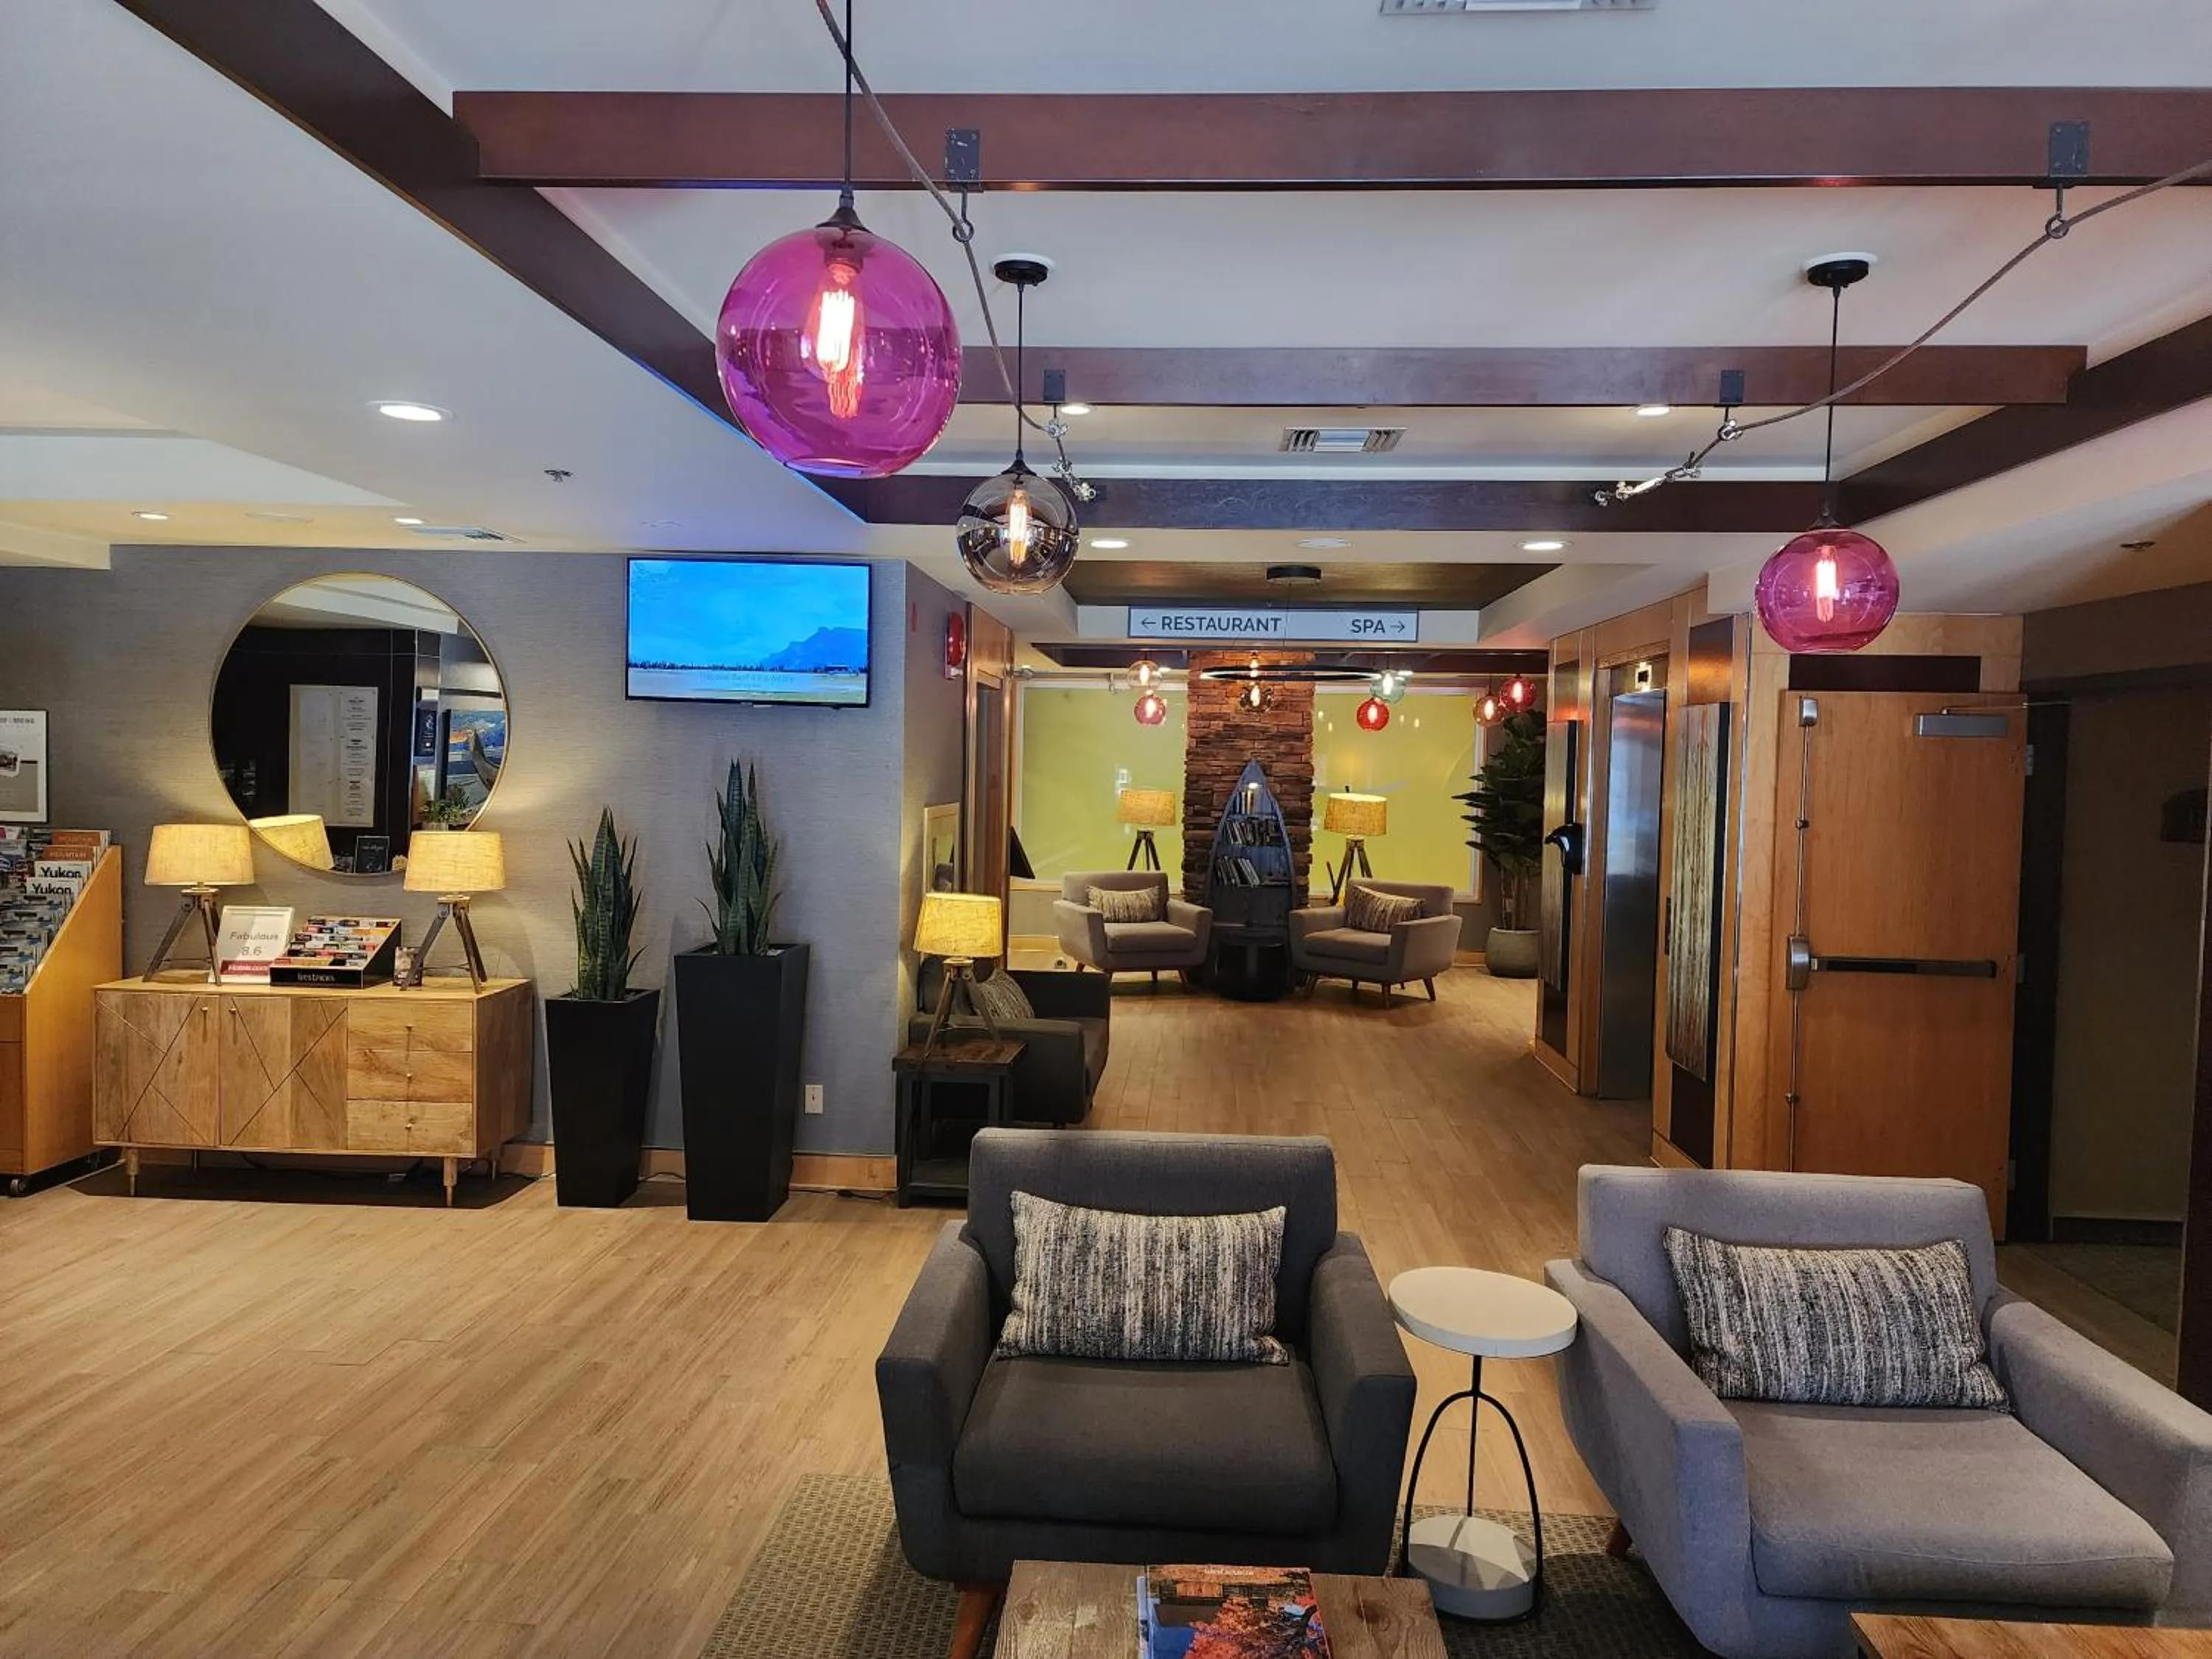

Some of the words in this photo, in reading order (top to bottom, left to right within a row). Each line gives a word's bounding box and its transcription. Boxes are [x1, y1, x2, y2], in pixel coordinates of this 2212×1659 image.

[1161, 616, 1282, 633] RESTAURANT
[1350, 619, 1386, 634] SPA
[41, 866, 83, 877] Yukon
[32, 883, 72, 894] Yukon
[229, 931, 279, 941] Fabulous
[241, 946, 262, 956] 8.6
